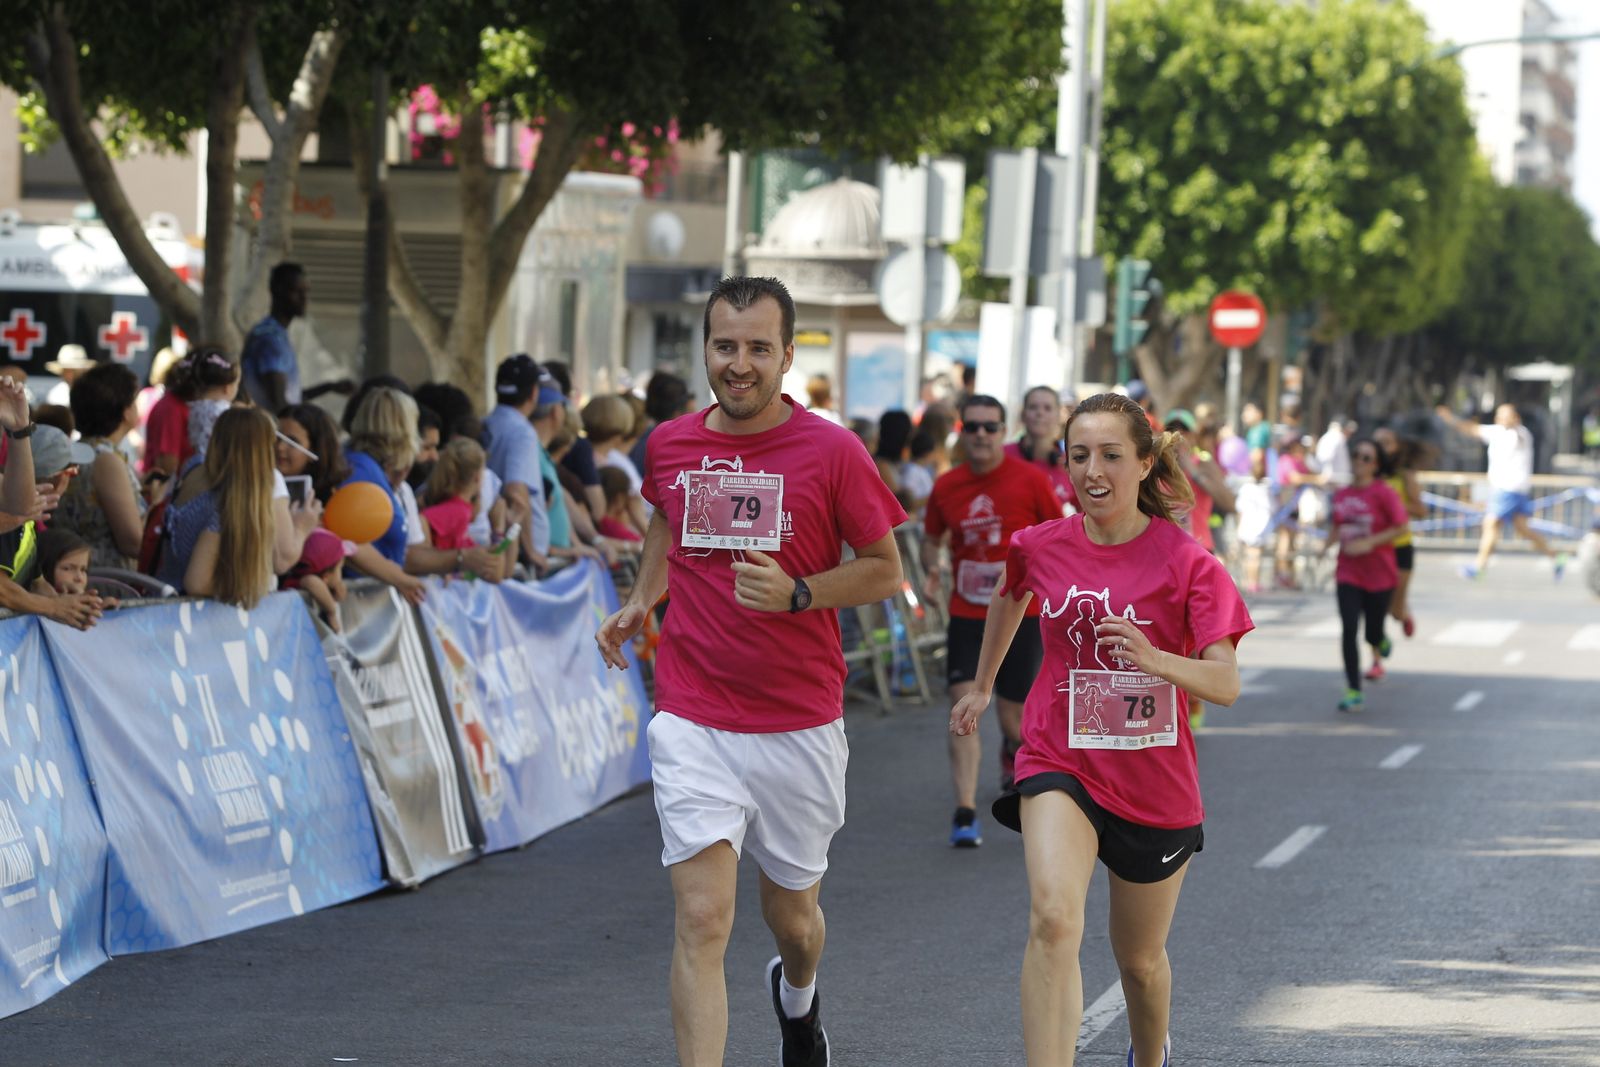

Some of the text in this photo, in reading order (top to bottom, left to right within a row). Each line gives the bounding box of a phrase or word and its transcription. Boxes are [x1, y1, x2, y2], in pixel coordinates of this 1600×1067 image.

[723, 476, 749, 484] CARRERA
[749, 478, 778, 486] SOLIDARIA
[730, 495, 761, 521] 79
[1115, 675, 1141, 684] CARRERA
[1123, 695, 1156, 720] 78
[1125, 720, 1149, 728] MARTA
